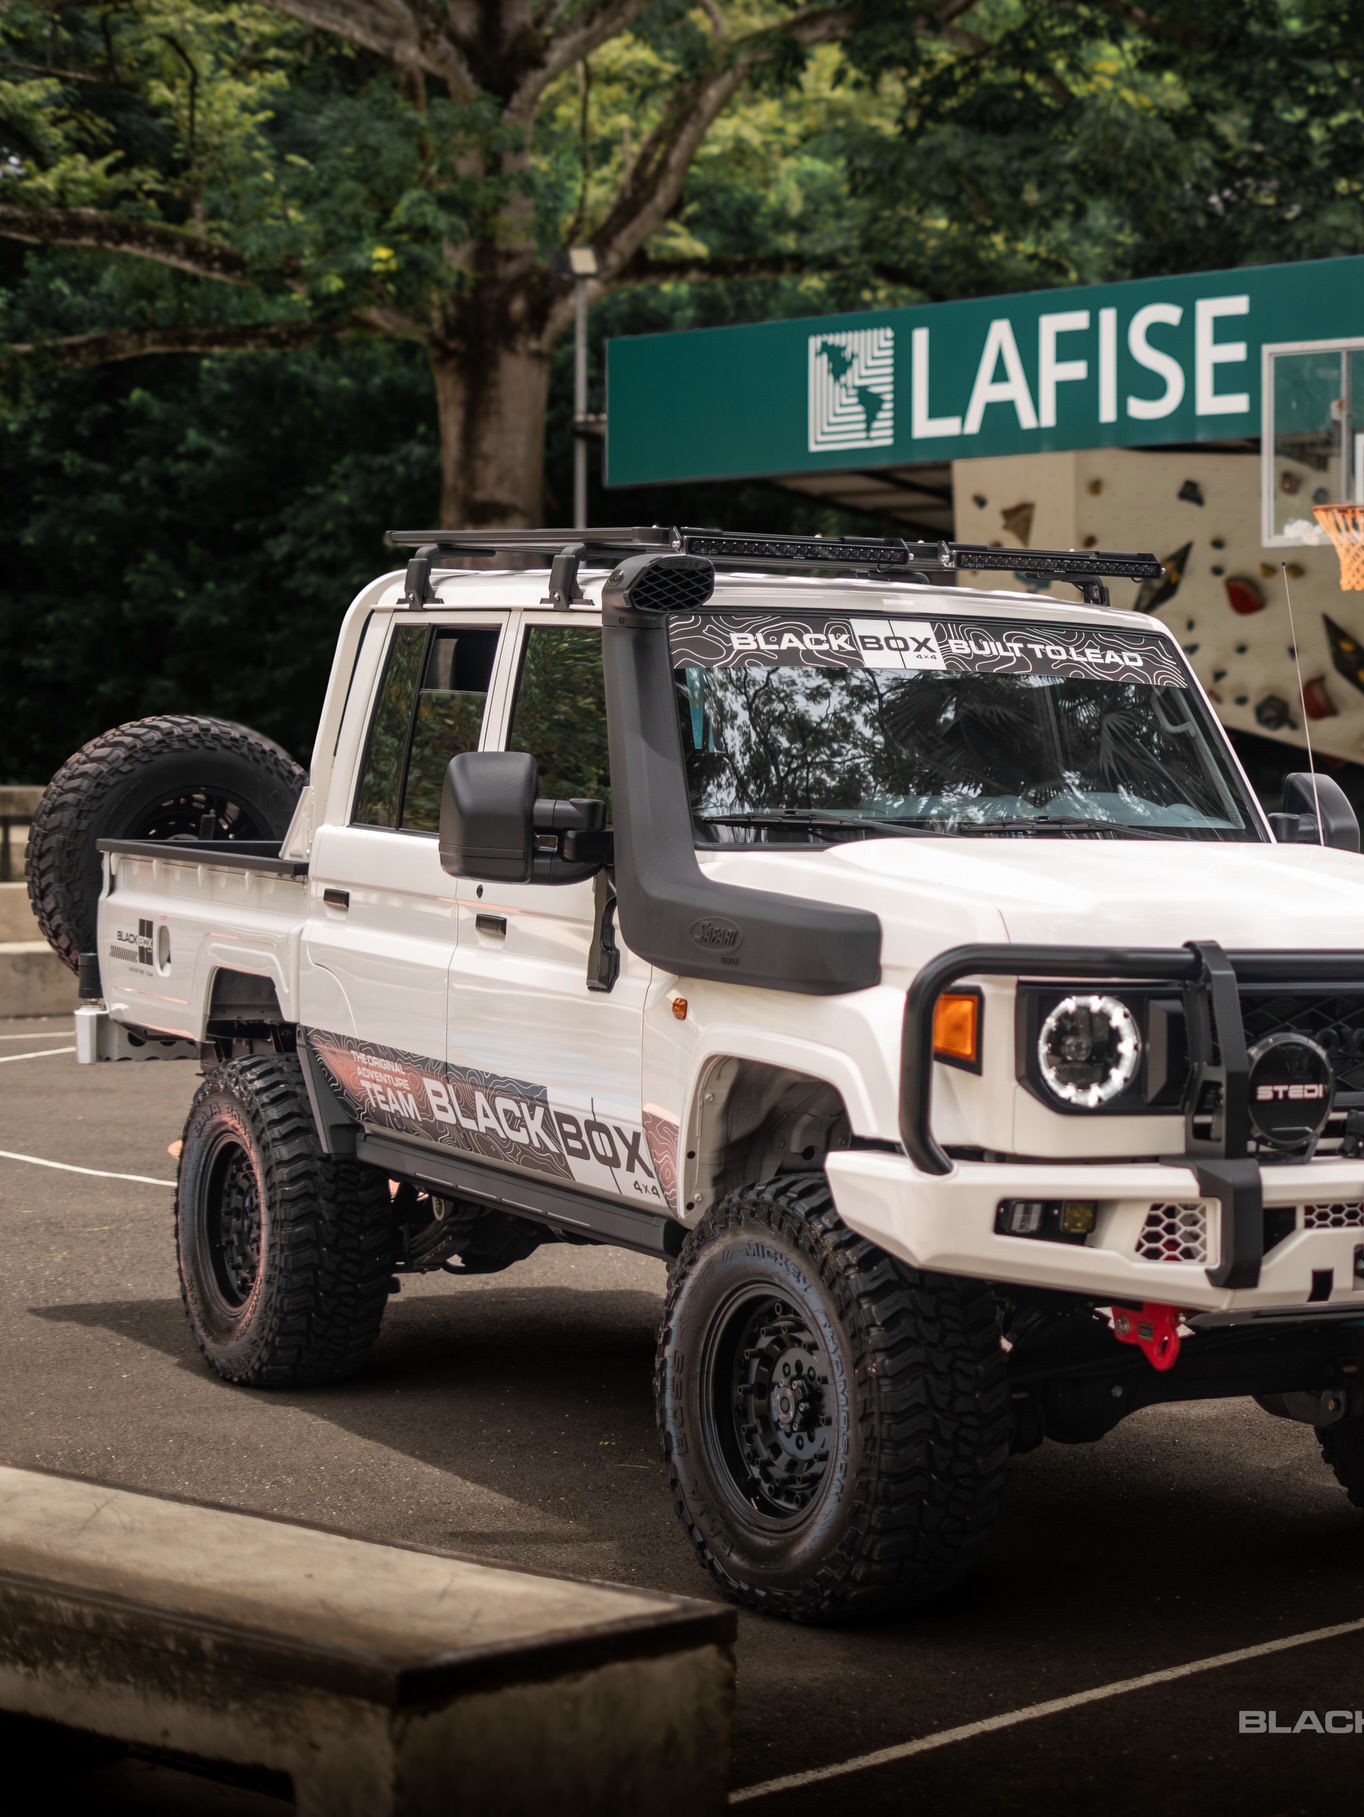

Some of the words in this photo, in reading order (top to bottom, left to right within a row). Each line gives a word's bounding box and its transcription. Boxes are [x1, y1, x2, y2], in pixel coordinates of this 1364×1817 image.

[911, 294, 1250, 440] LAFISE
[729, 632, 858, 651] BLACK
[858, 635, 938, 653] BOX
[948, 638, 1025, 658] BUILT
[1027, 643, 1069, 661] TO
[1070, 646, 1143, 667] LEAD
[350, 1050, 368, 1065] THE
[367, 1055, 407, 1075] ORIGINAL
[356, 1065, 411, 1091] ADVENTURE
[360, 1079, 422, 1122] TEAM
[1256, 1084, 1324, 1100] STEDI
[423, 1077, 562, 1154] BLACK
[553, 1110, 655, 1179] BOX
